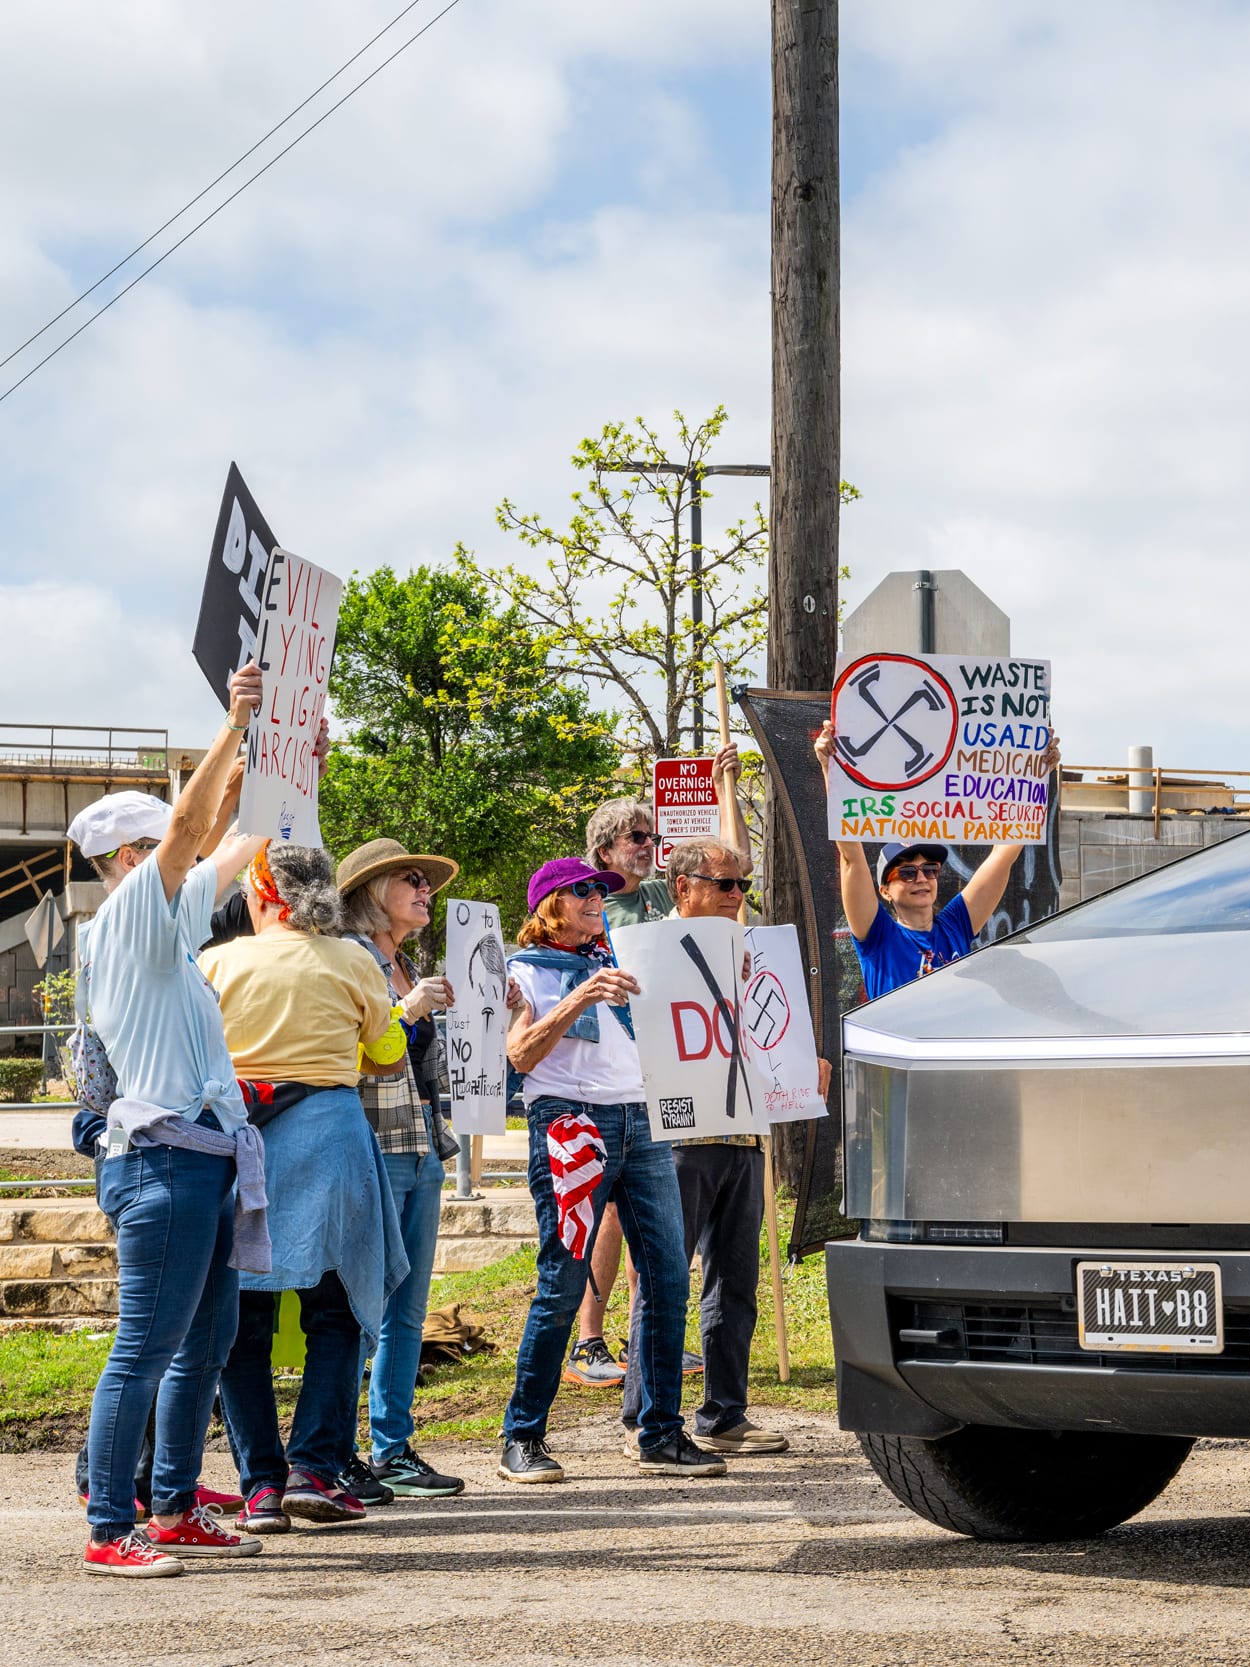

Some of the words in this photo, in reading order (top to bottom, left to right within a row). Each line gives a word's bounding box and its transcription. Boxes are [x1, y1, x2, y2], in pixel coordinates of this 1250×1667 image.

[264, 553, 324, 631] EVIL
[259, 618, 326, 684] LYING
[959, 662, 1046, 690] WASTE
[960, 694, 996, 717] IS
[1001, 693, 1049, 719] NOT
[963, 722, 1050, 750] USAID
[680, 763, 697, 775] NO
[957, 750, 1049, 779] MEDICAID
[658, 777, 713, 789] OVERNIGH
[945, 774, 1049, 805] EDUCATION
[665, 790, 712, 803] PARKING
[660, 809, 696, 817] UNAUTHORIZED
[842, 794, 896, 818] IRS
[900, 801, 982, 819] SOCIAL
[987, 801, 1048, 826] SECURITY
[841, 817, 956, 839] NATIONAL
[963, 821, 1042, 841] PARKS!!!
[481, 909, 494, 929] to
[448, 1010, 471, 1030] Just
[451, 1037, 472, 1063] NO
[660, 1099, 692, 1114] RESIST
[662, 1112, 694, 1128] TYRANNY
[1117, 1270, 1182, 1281] TEXAS
[1096, 1288, 1158, 1326] HAIT
